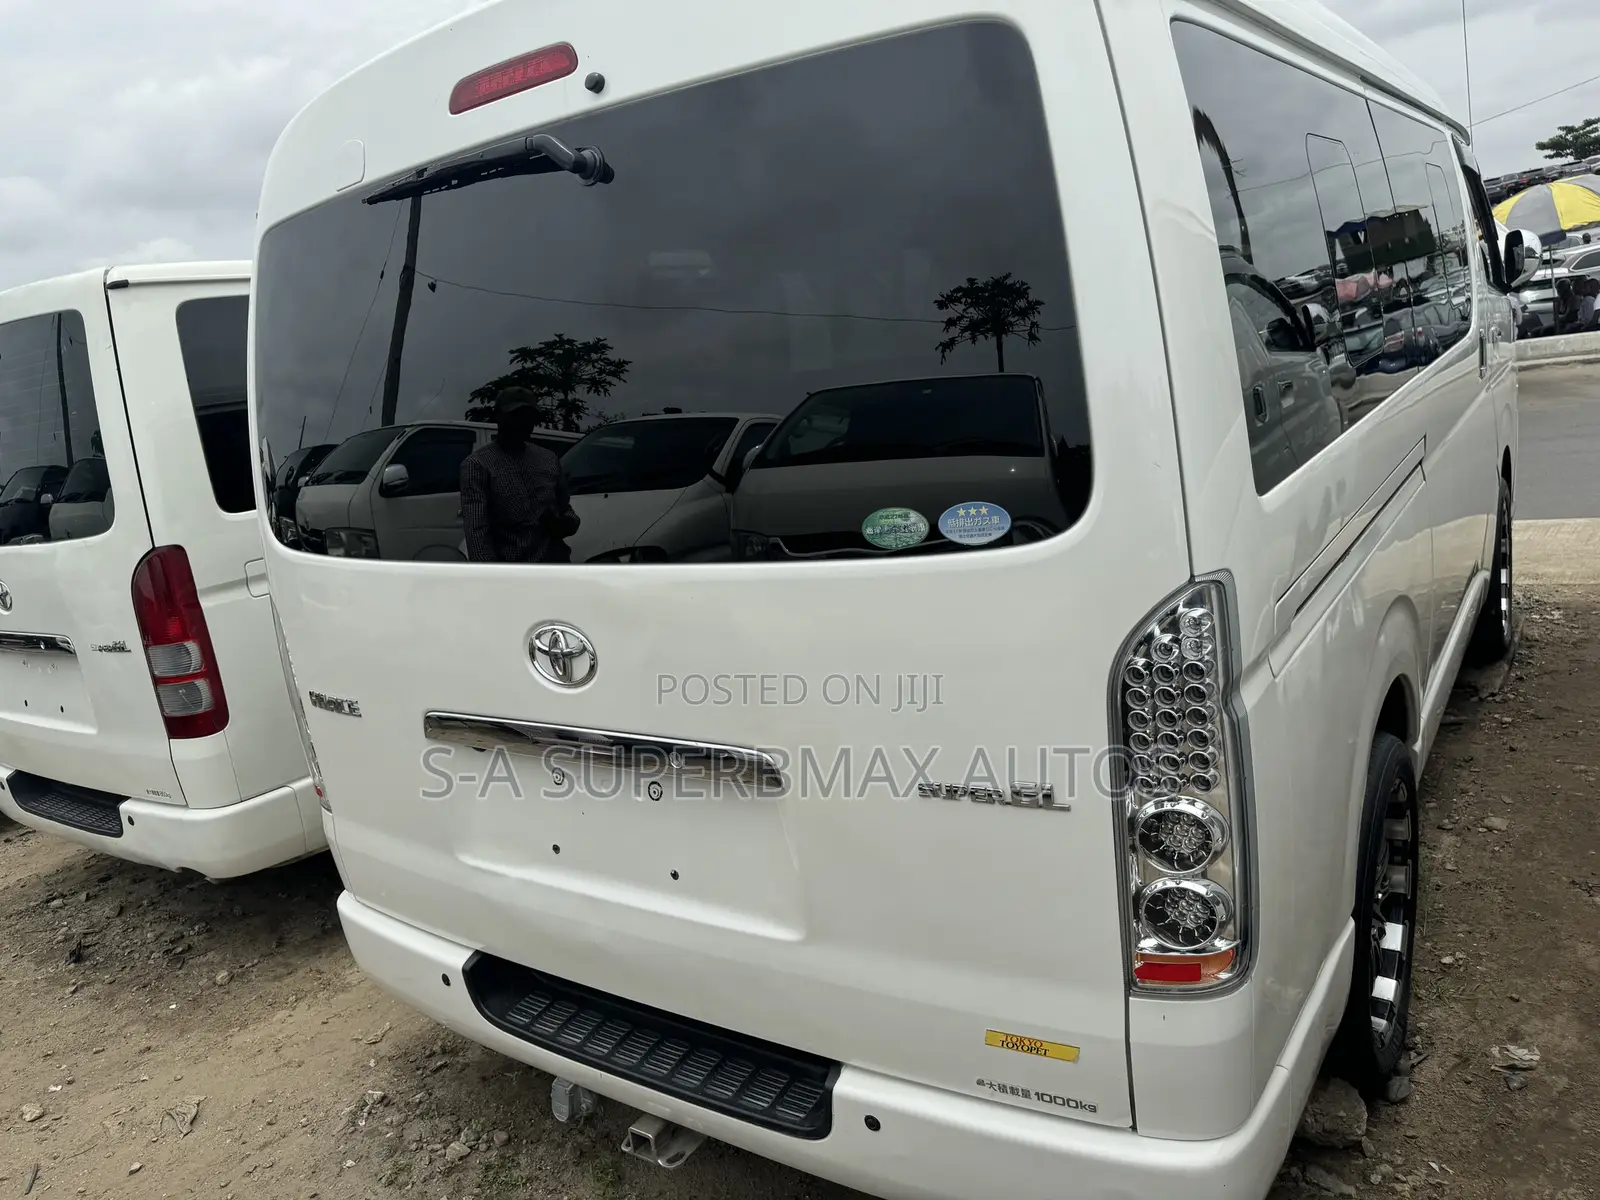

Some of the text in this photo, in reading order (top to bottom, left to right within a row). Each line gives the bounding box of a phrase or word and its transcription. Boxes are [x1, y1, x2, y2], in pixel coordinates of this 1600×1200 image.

[1000, 1040, 1049, 1056] TOYOPET
[1003, 1034, 1044, 1048] TOKYO
[1034, 1091, 1097, 1113] 1000kg
